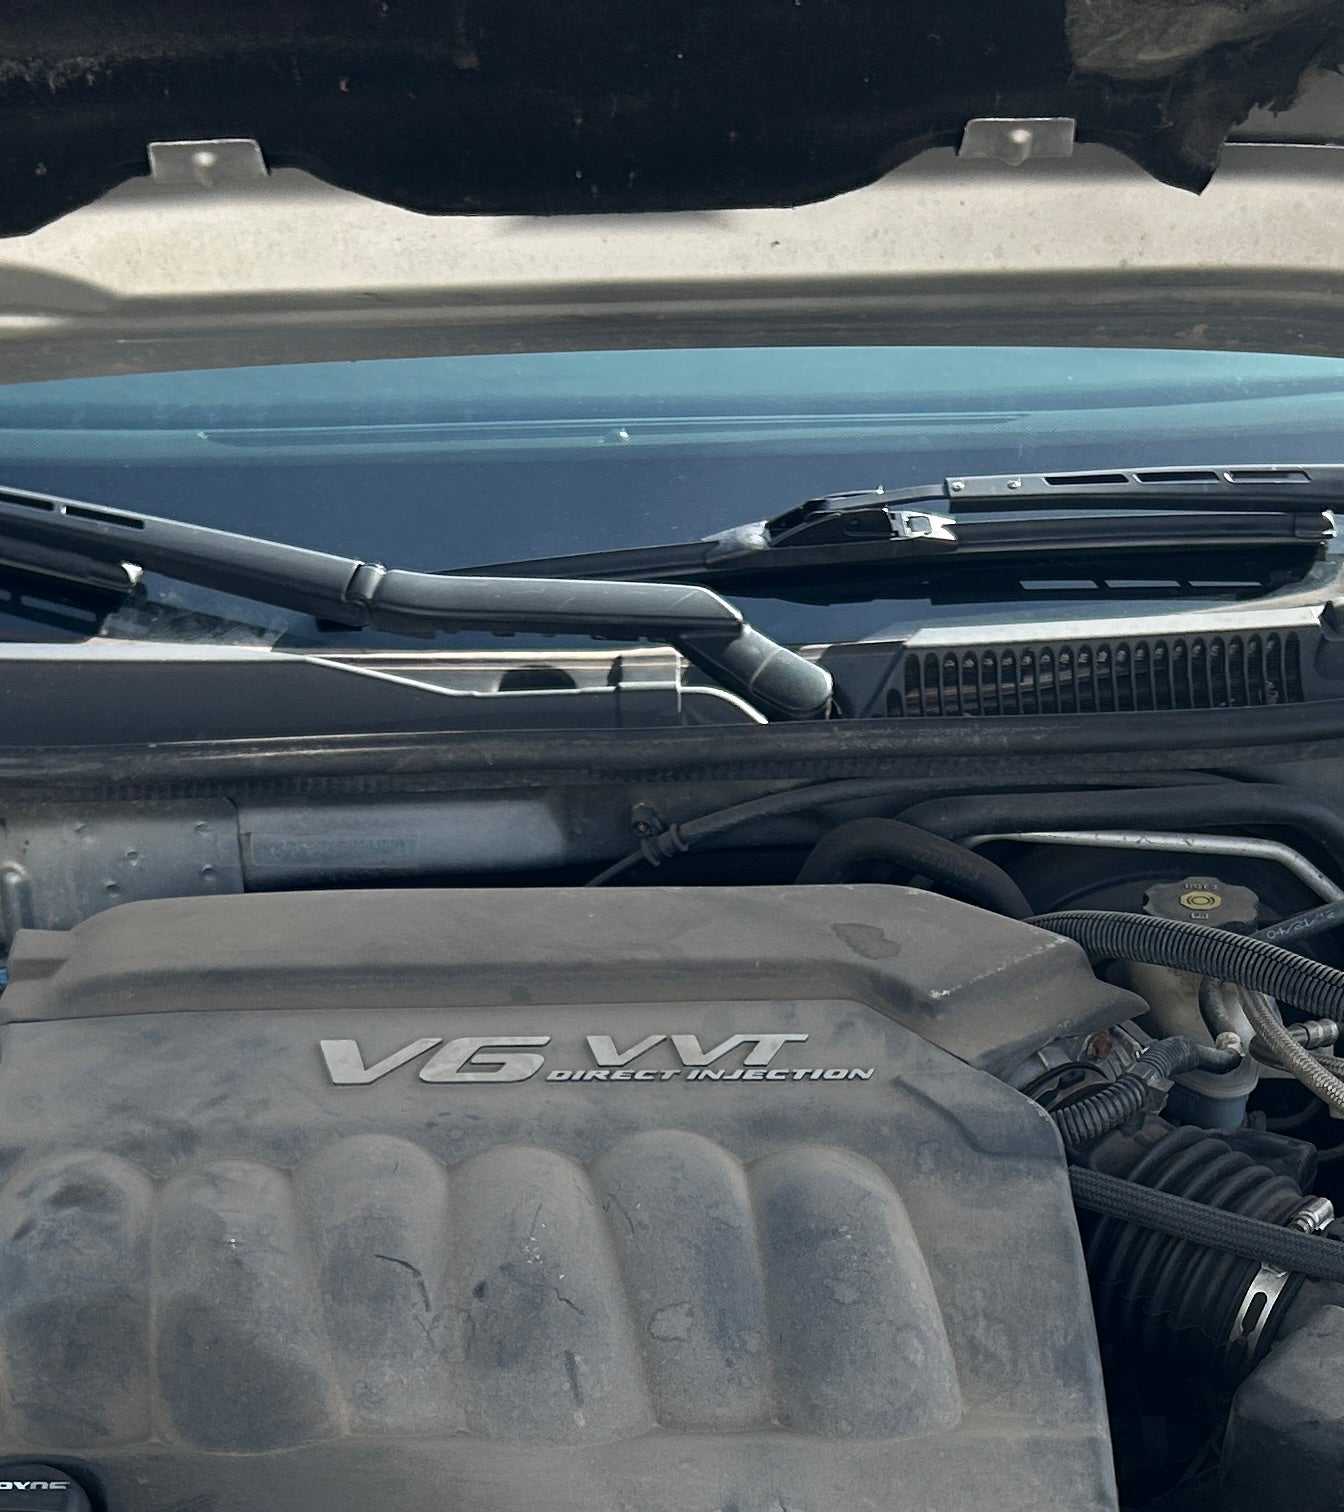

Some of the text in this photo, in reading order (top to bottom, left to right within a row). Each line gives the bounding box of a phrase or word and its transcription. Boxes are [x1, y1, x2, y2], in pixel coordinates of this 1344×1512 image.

[318, 1032, 810, 1086] V6 VVT
[545, 1065, 876, 1083] DIRECT INJECTION
